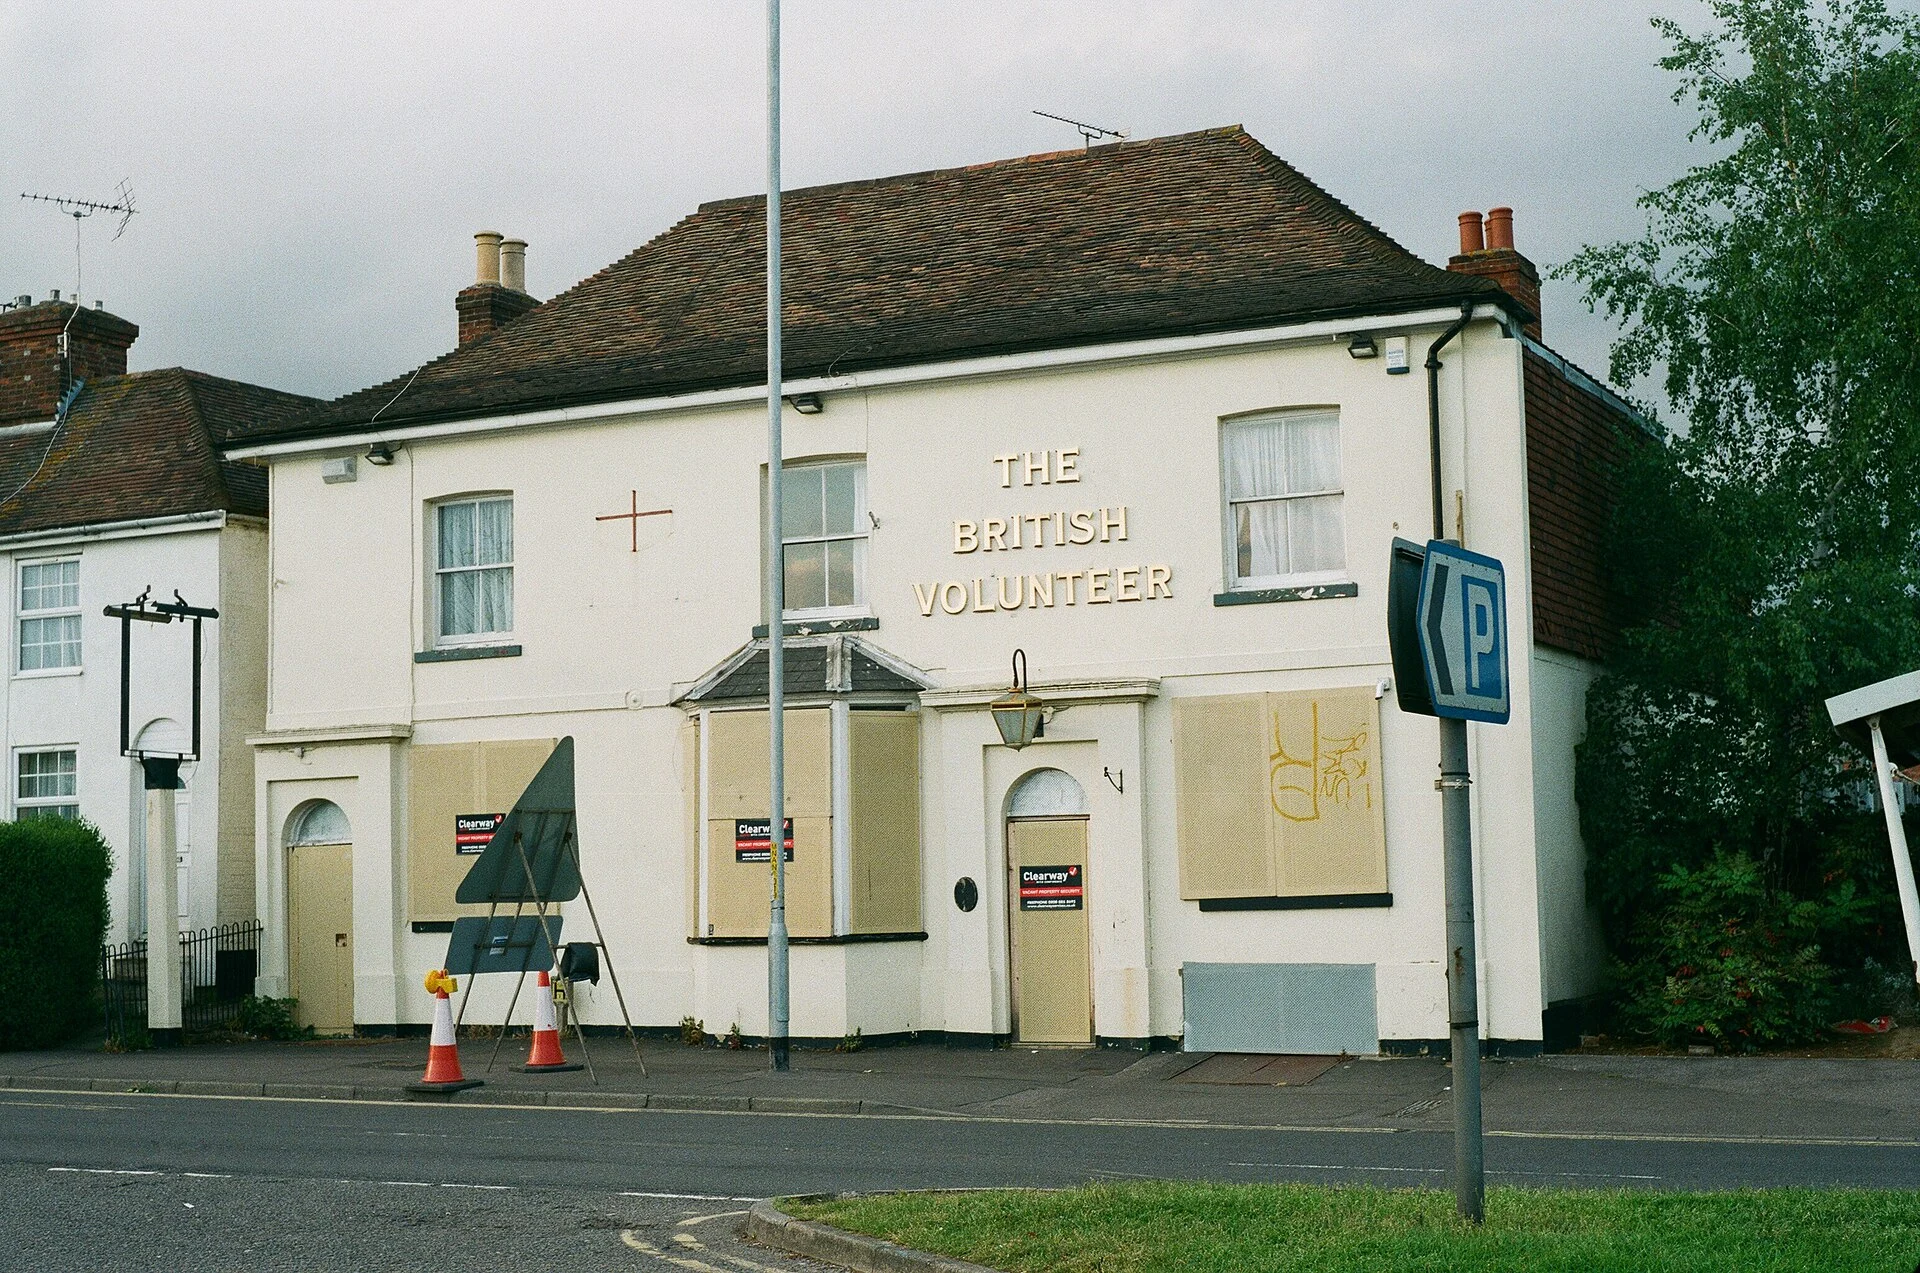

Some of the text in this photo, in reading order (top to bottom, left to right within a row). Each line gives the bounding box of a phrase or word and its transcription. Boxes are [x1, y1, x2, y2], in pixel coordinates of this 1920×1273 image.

[993, 447, 1080, 488] THE
[953, 506, 1128, 554] BRITISH
[912, 564, 1173, 617] VOLUNTEER
[1467, 583, 1494, 689] P
[459, 820, 494, 828] Clearway
[739, 825, 770, 833] Clearw
[1024, 872, 1068, 881] Clearway
